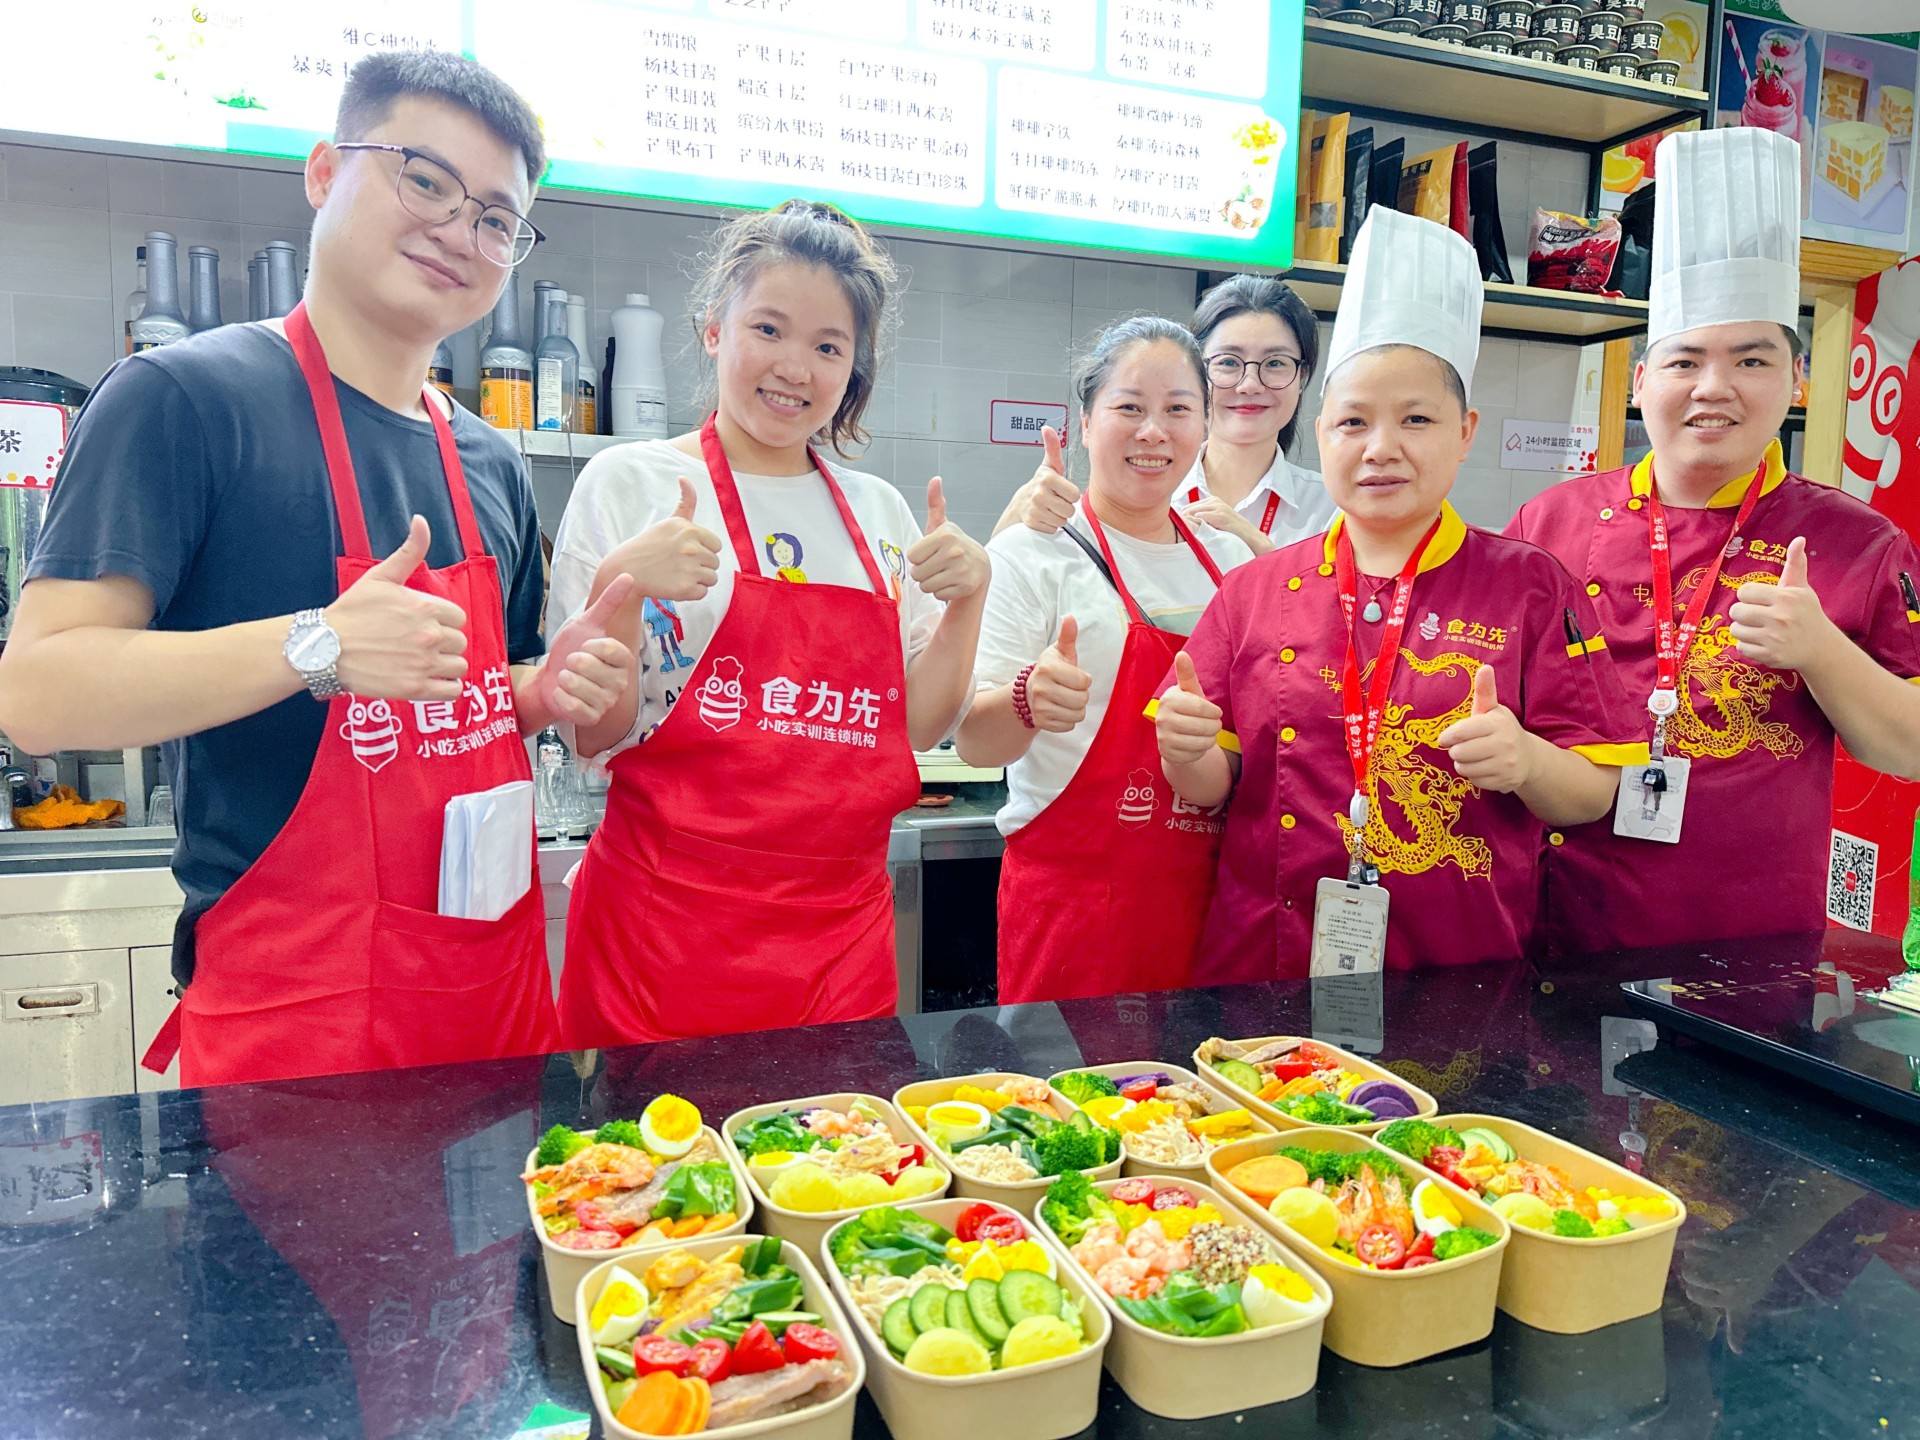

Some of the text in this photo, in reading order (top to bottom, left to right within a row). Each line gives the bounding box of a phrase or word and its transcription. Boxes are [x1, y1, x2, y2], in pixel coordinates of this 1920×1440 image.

[1631, 33, 1661, 51] 臭豆
[645, 56, 717, 81] 杨枝甘露
[646, 84, 717, 108] 芒果班戟
[646, 110, 717, 135] 榴莲班戟
[647, 138, 717, 160] 芒果布丁
[840, 126, 969, 159] 杨枝甘露芒果凉粉
[740, 148, 825, 173] 芒果西米露
[841, 160, 968, 192] 杨枝甘露白雪珍珠
[1011, 416, 1047, 431] 甜品区
[0, 429, 22, 454] 茶
[1525, 436, 1582, 448] 24小时监控区域
[1443, 634, 1505, 651] 小吃实训连锁机构
[1447, 618, 1507, 644] 食为先
[409, 667, 512, 733] 食为先
[760, 676, 881, 729] 食为先
[756, 716, 877, 748] 小吃实训连锁机构
